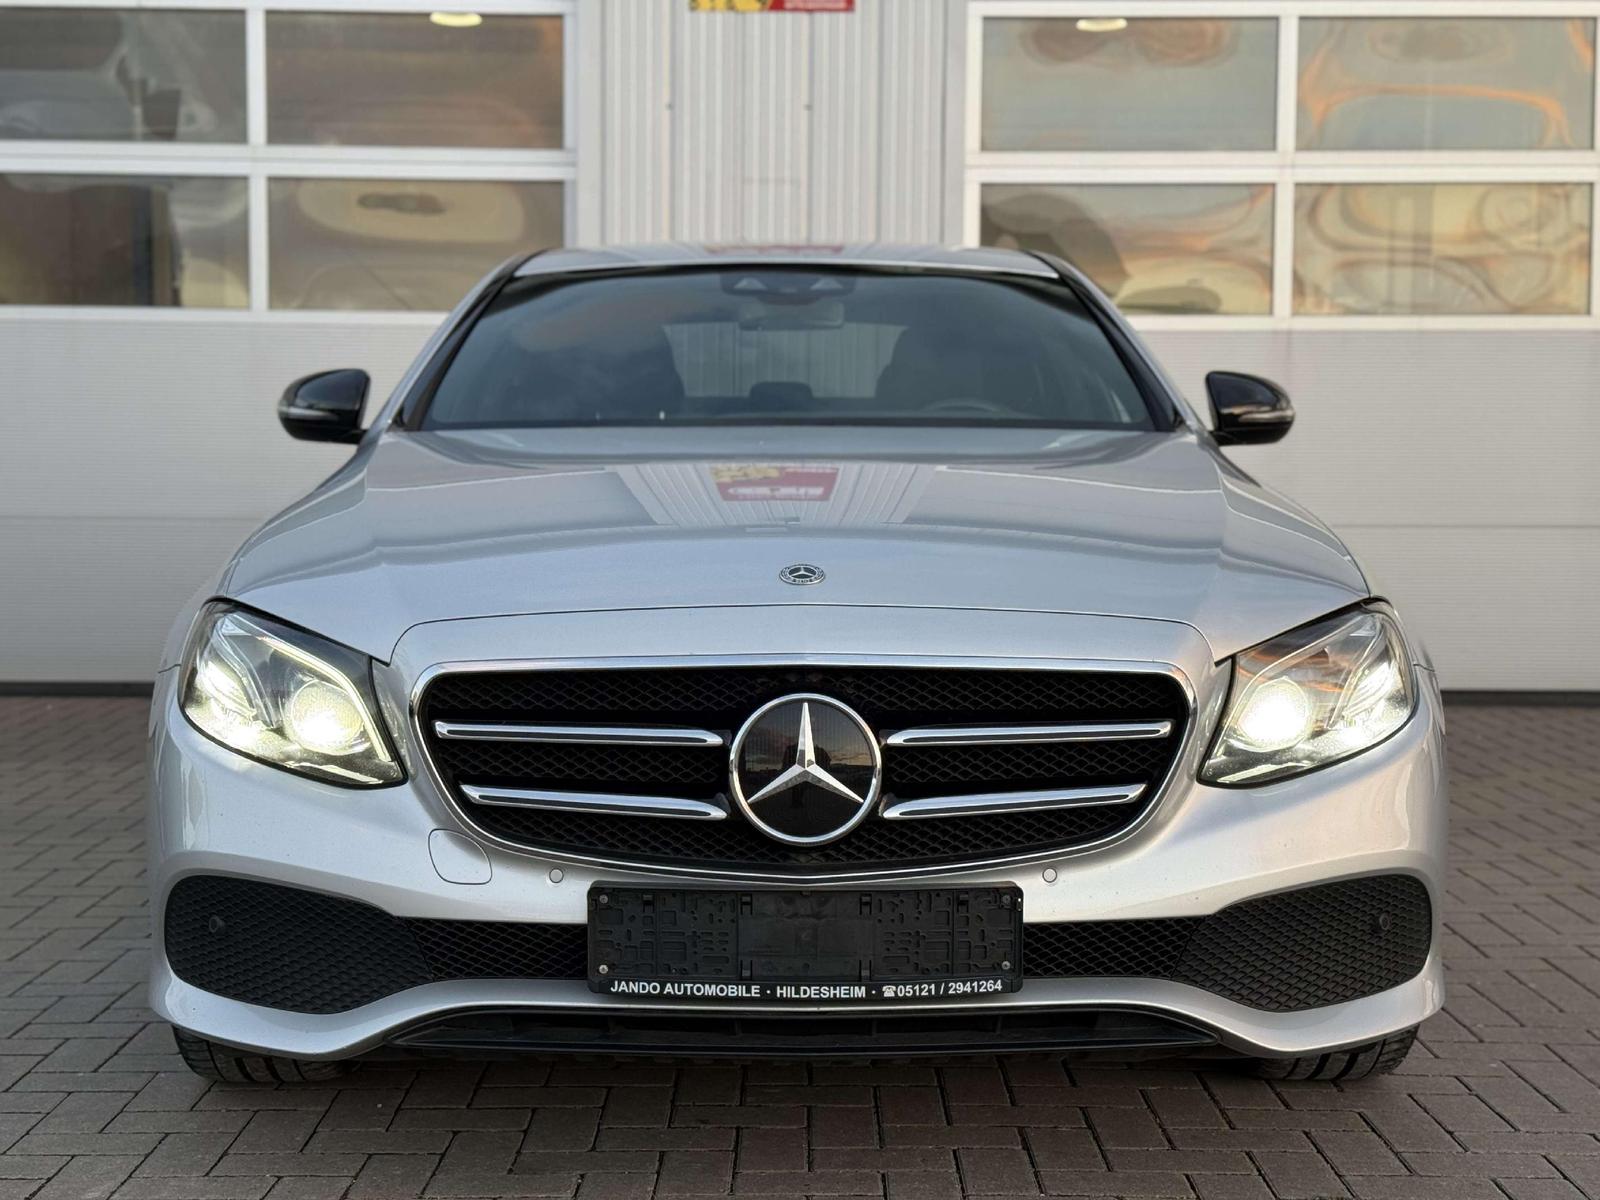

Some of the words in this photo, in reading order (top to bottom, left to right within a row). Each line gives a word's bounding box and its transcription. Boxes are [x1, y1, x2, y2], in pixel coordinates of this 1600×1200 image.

[610, 980, 661, 994] JANDO
[663, 983, 761, 998] AUTOMOBILE
[775, 985, 866, 998] HILDESHEIM
[947, 980, 1003, 996] 2941264
